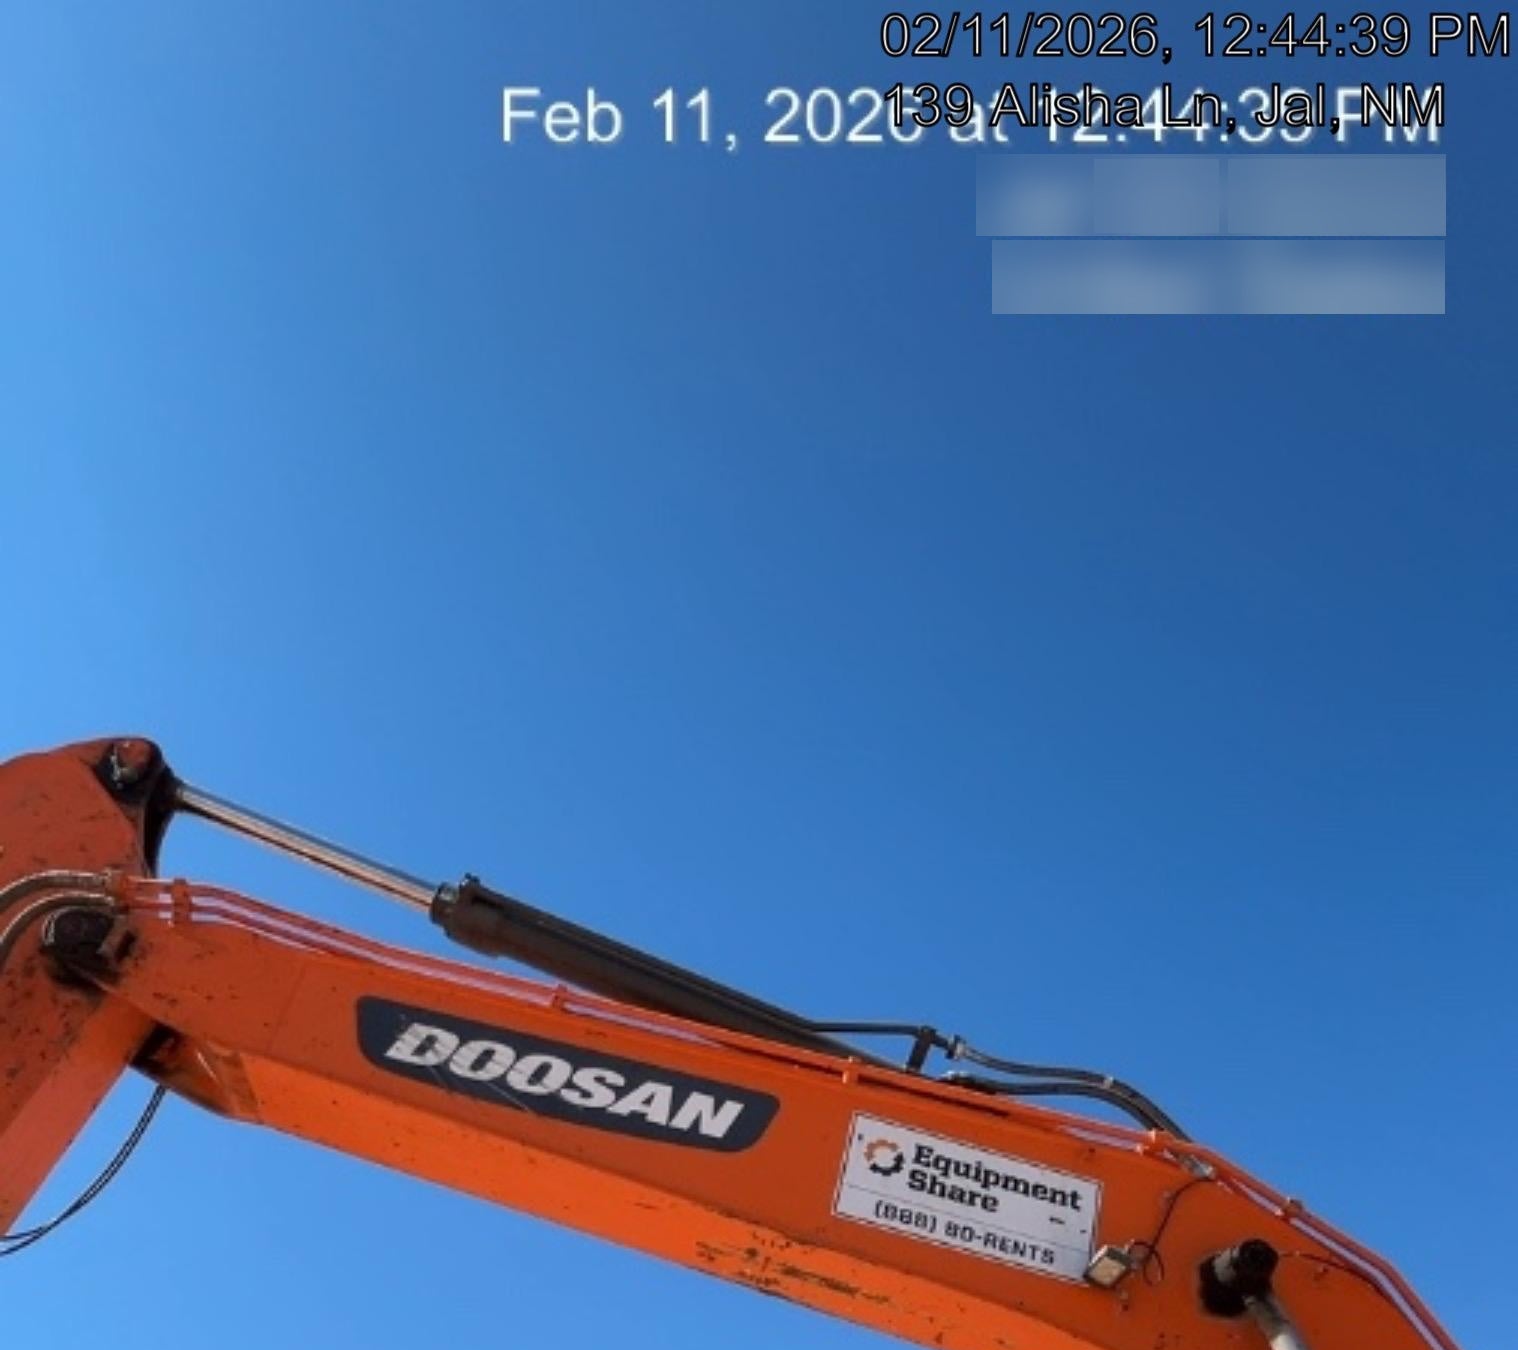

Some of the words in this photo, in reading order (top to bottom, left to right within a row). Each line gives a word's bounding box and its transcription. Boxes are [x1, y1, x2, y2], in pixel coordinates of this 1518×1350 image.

[385, 1022, 746, 1139] DOOSAN
[908, 1169, 1000, 1213] Share
[911, 1142, 1082, 1211] Equipment
[874, 1199, 938, 1234] (888)
[944, 1219, 1056, 1265] 80-RENTS
